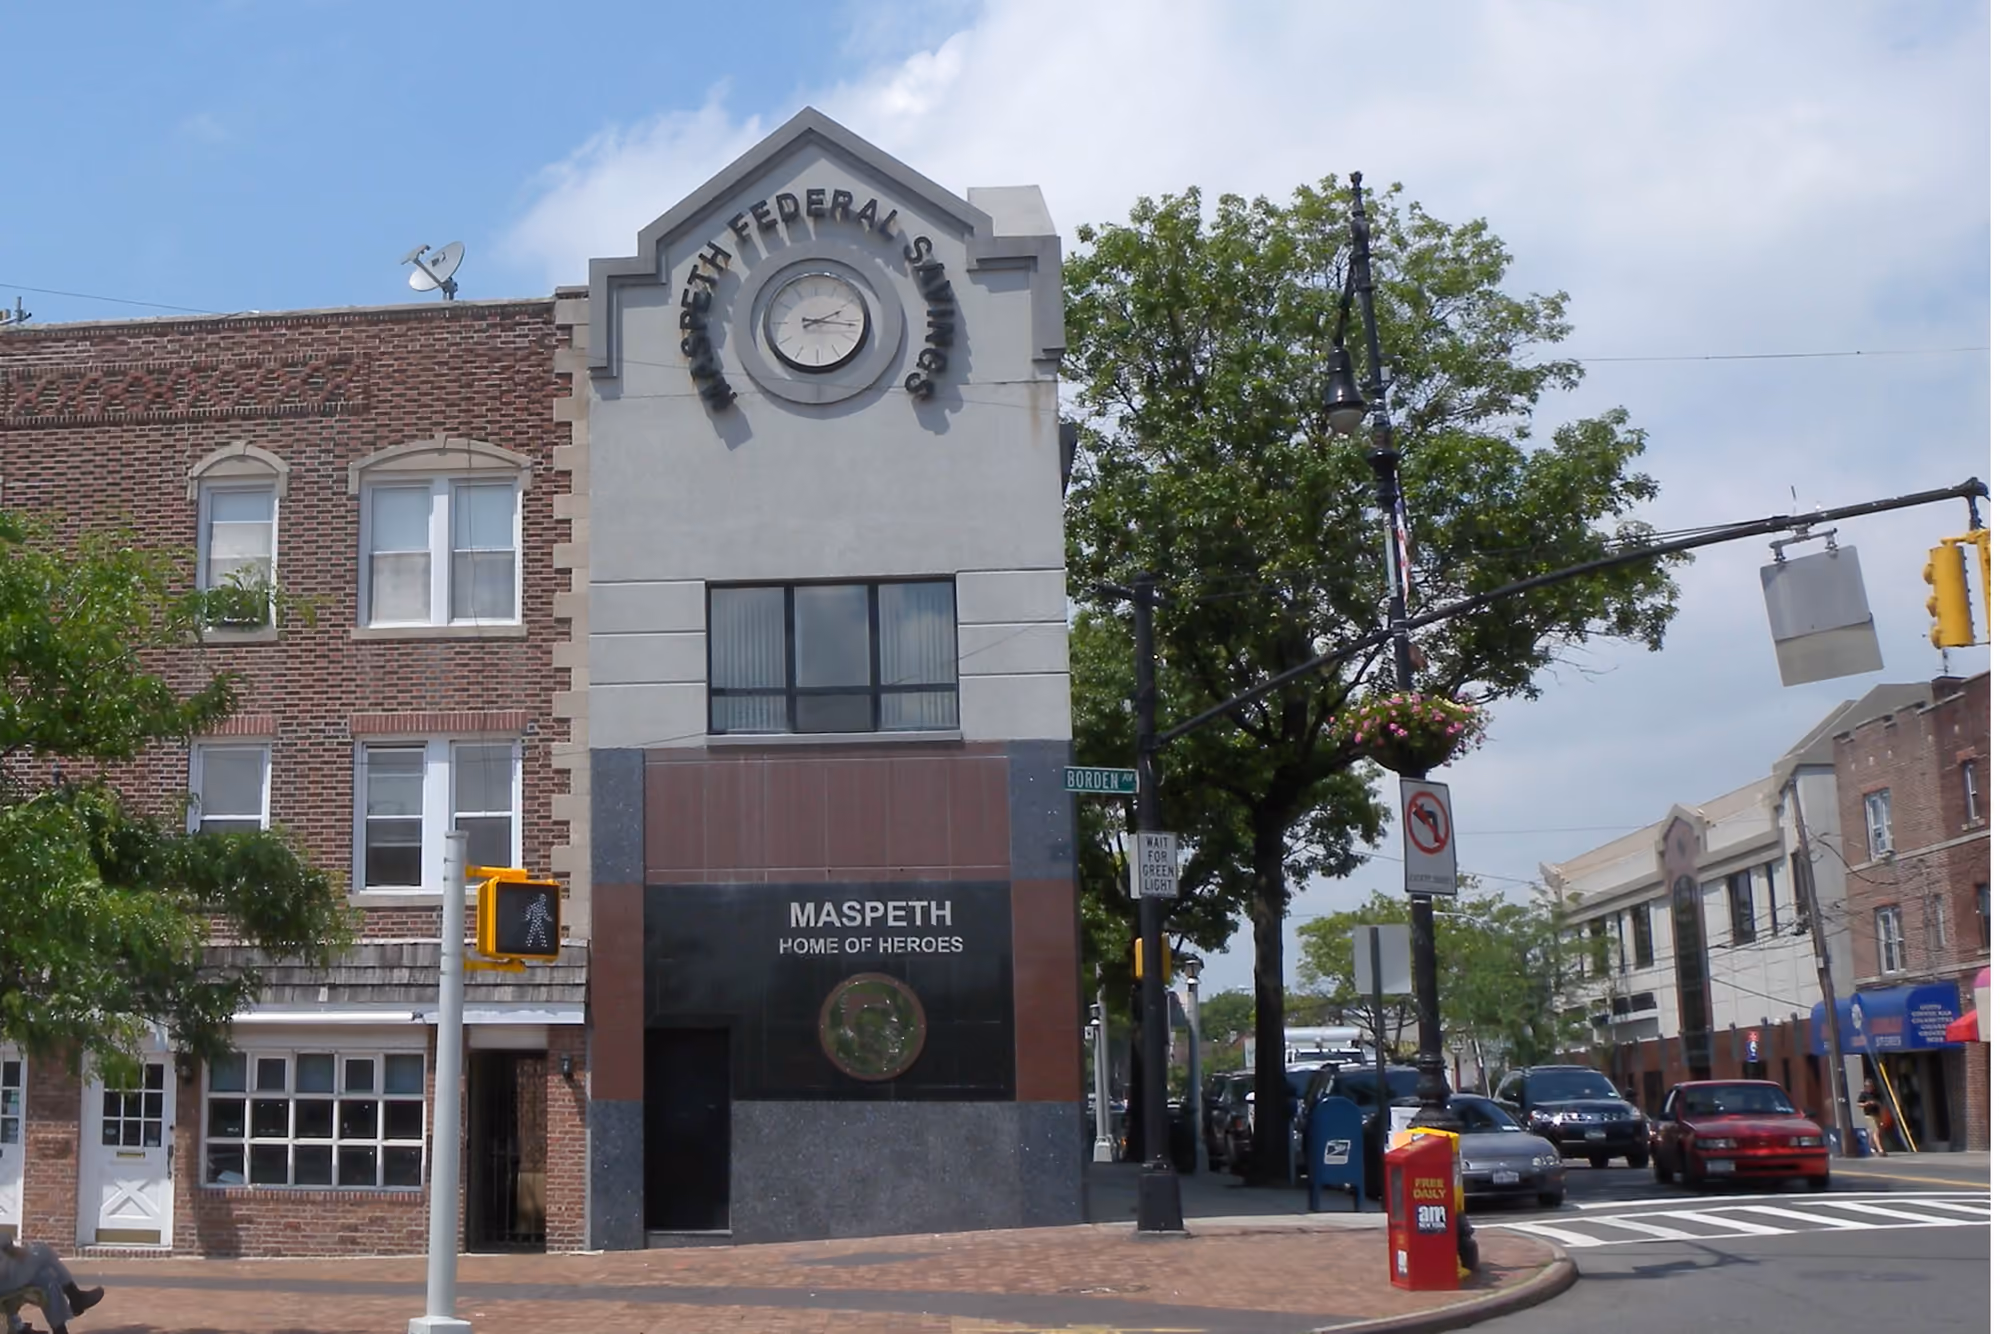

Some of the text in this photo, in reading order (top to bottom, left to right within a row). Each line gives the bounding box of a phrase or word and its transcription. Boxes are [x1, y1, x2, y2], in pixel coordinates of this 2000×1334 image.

[727, 188, 898, 244] FEDERAL
[904, 236, 956, 401] SAVINGS
[1066, 770, 1119, 789] BORDEN
[1145, 837, 1168, 849] WAIT
[1147, 850, 1168, 862] FOR
[1142, 864, 1175, 878] GREEN
[1144, 879, 1172, 891] LIGHT
[789, 900, 952, 929] MASPETH
[779, 936, 964, 955] HOME OF HEROES
[1414, 1177, 1444, 1188] FREE
[1412, 1188, 1447, 1199] DAILY
